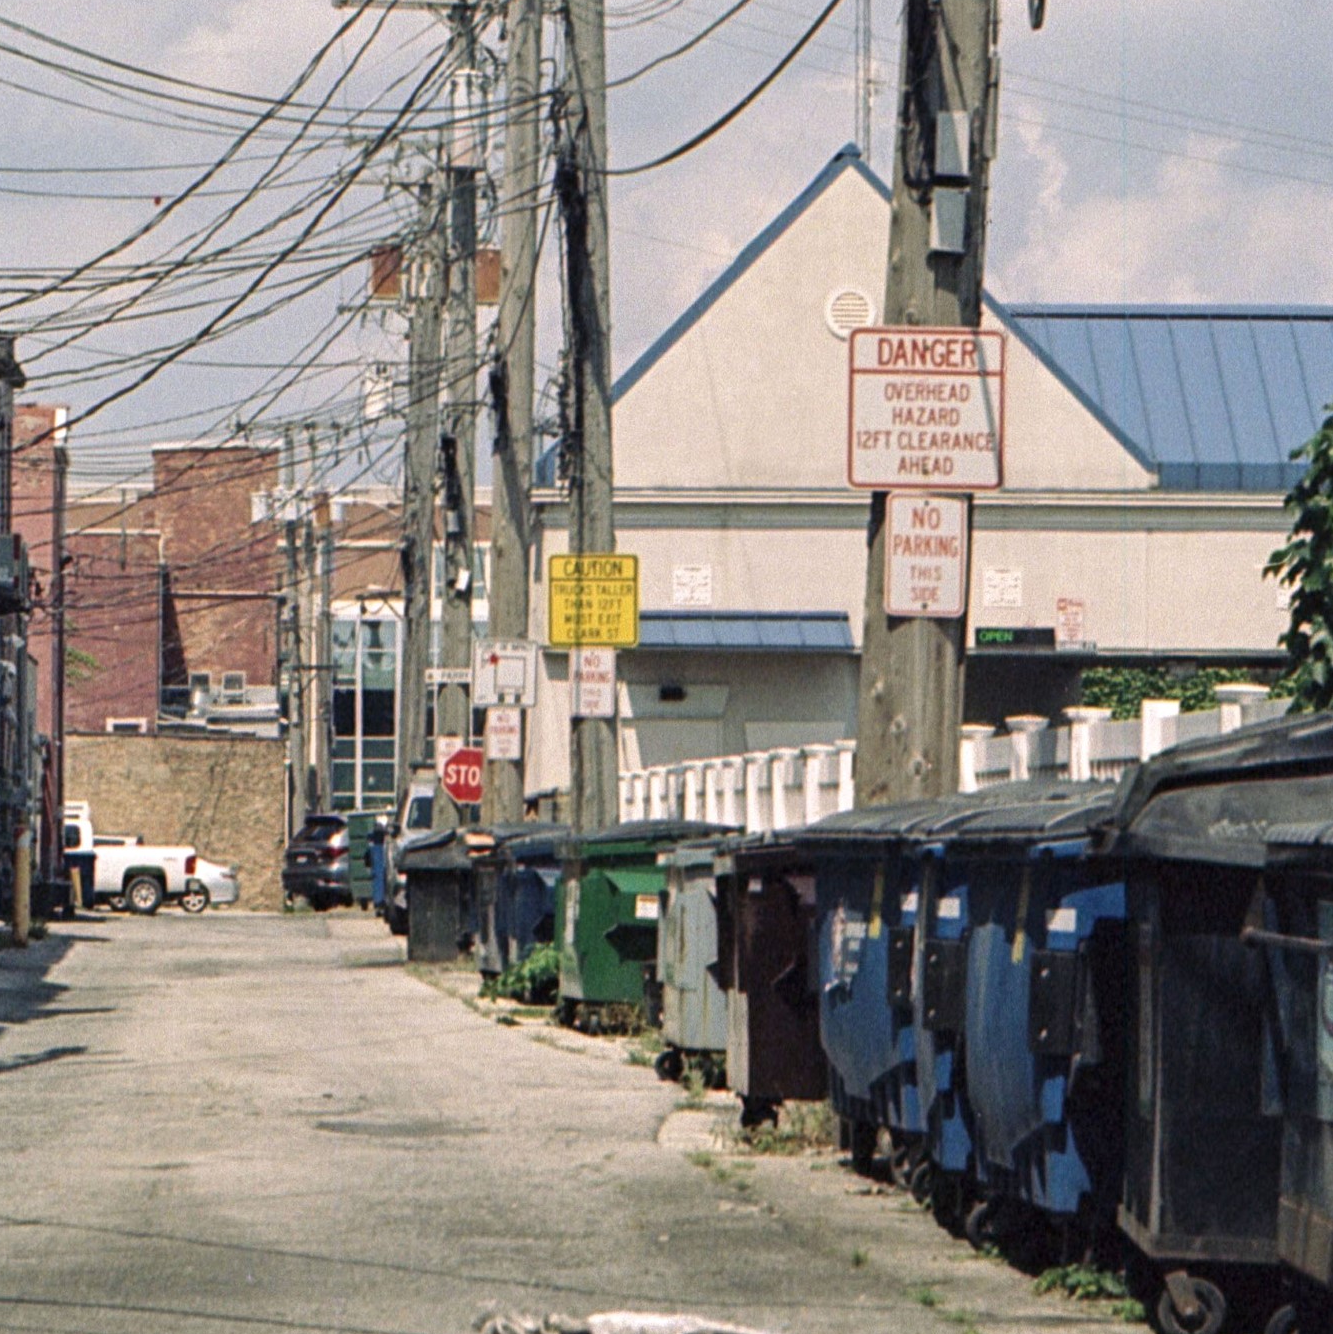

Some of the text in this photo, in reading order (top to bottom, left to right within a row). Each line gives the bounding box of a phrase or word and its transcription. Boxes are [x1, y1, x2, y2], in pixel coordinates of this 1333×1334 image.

[878, 337, 978, 367] DANGER
[884, 382, 970, 402] OVERHEAD
[892, 407, 960, 426] HAZARD
[857, 430, 996, 451] 12FT CLEARANCE
[897, 456, 954, 476] AHEAD
[912, 507, 941, 530] NO
[893, 534, 959, 558] PARKING
[564, 560, 623, 576] CAUTION
[910, 566, 942, 581] THIS
[596, 584, 633, 596] TALLER
[911, 586, 938, 602] SIDE
[979, 631, 1014, 642] OPEN
[446, 764, 480, 786] STO
